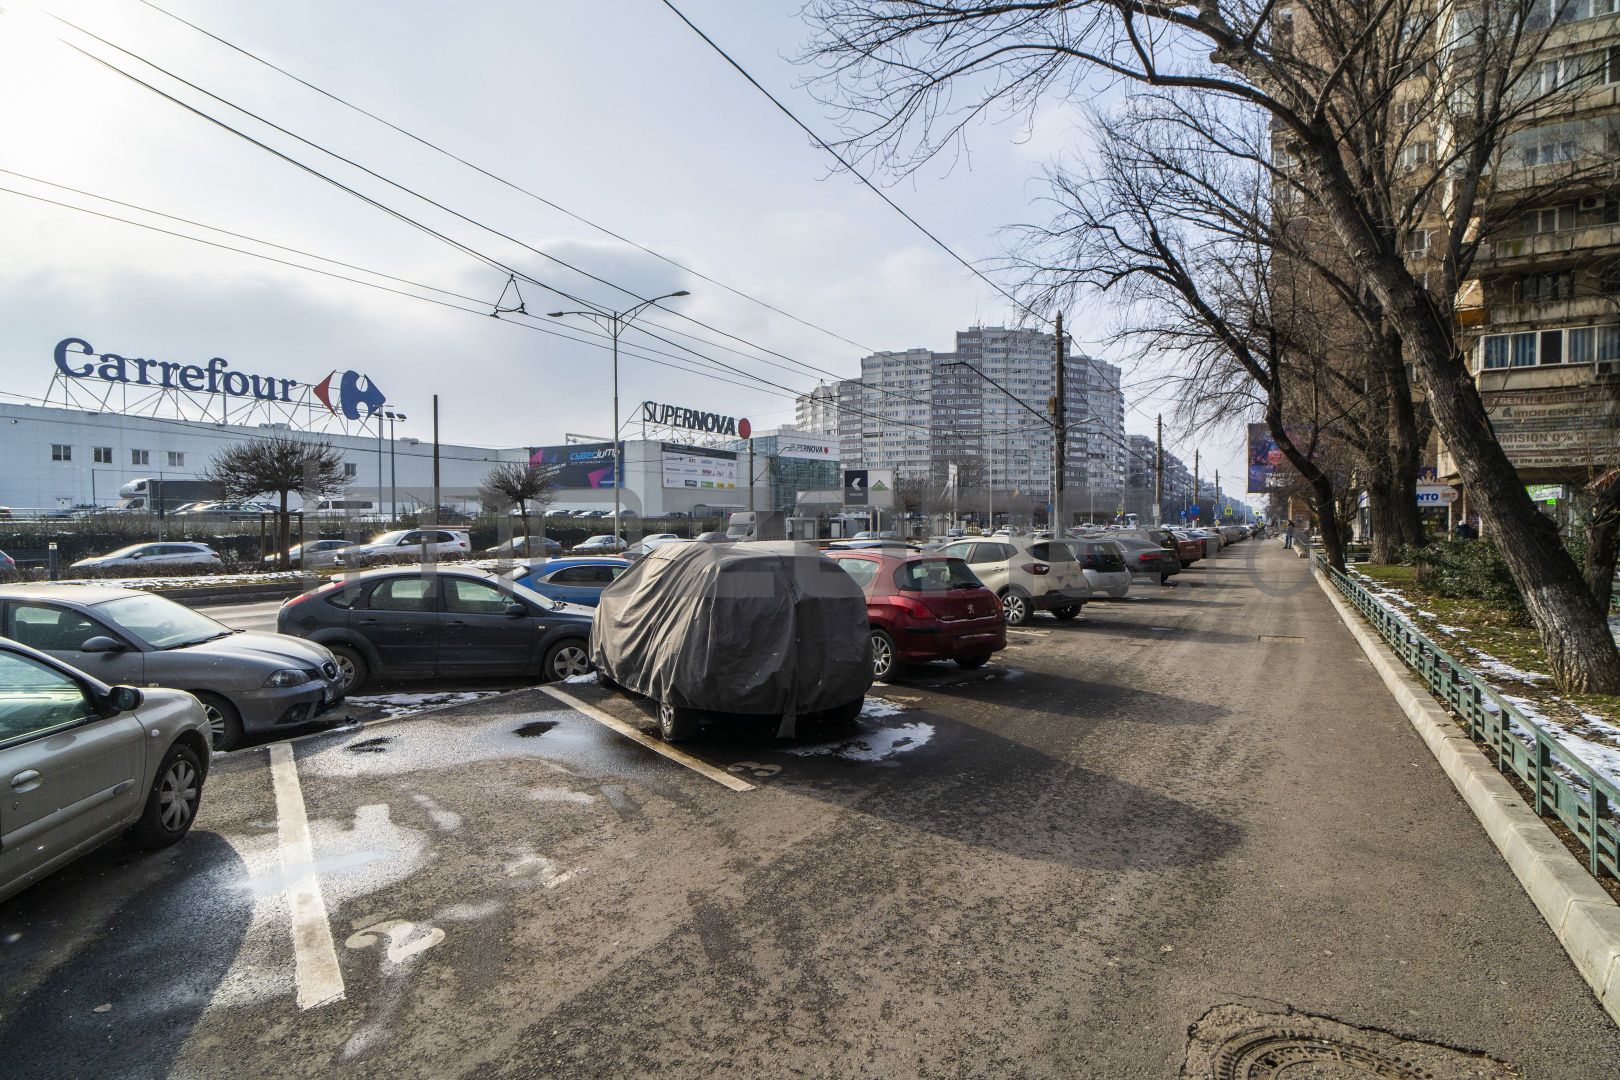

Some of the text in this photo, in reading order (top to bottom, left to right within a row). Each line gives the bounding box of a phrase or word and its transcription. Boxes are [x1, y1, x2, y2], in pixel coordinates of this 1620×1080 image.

[54, 338, 297, 402] Carrefour
[643, 401, 736, 436] SUPERNOVA
[791, 443, 823, 453] SUPERNOVA
[345, 919, 446, 963] 2
